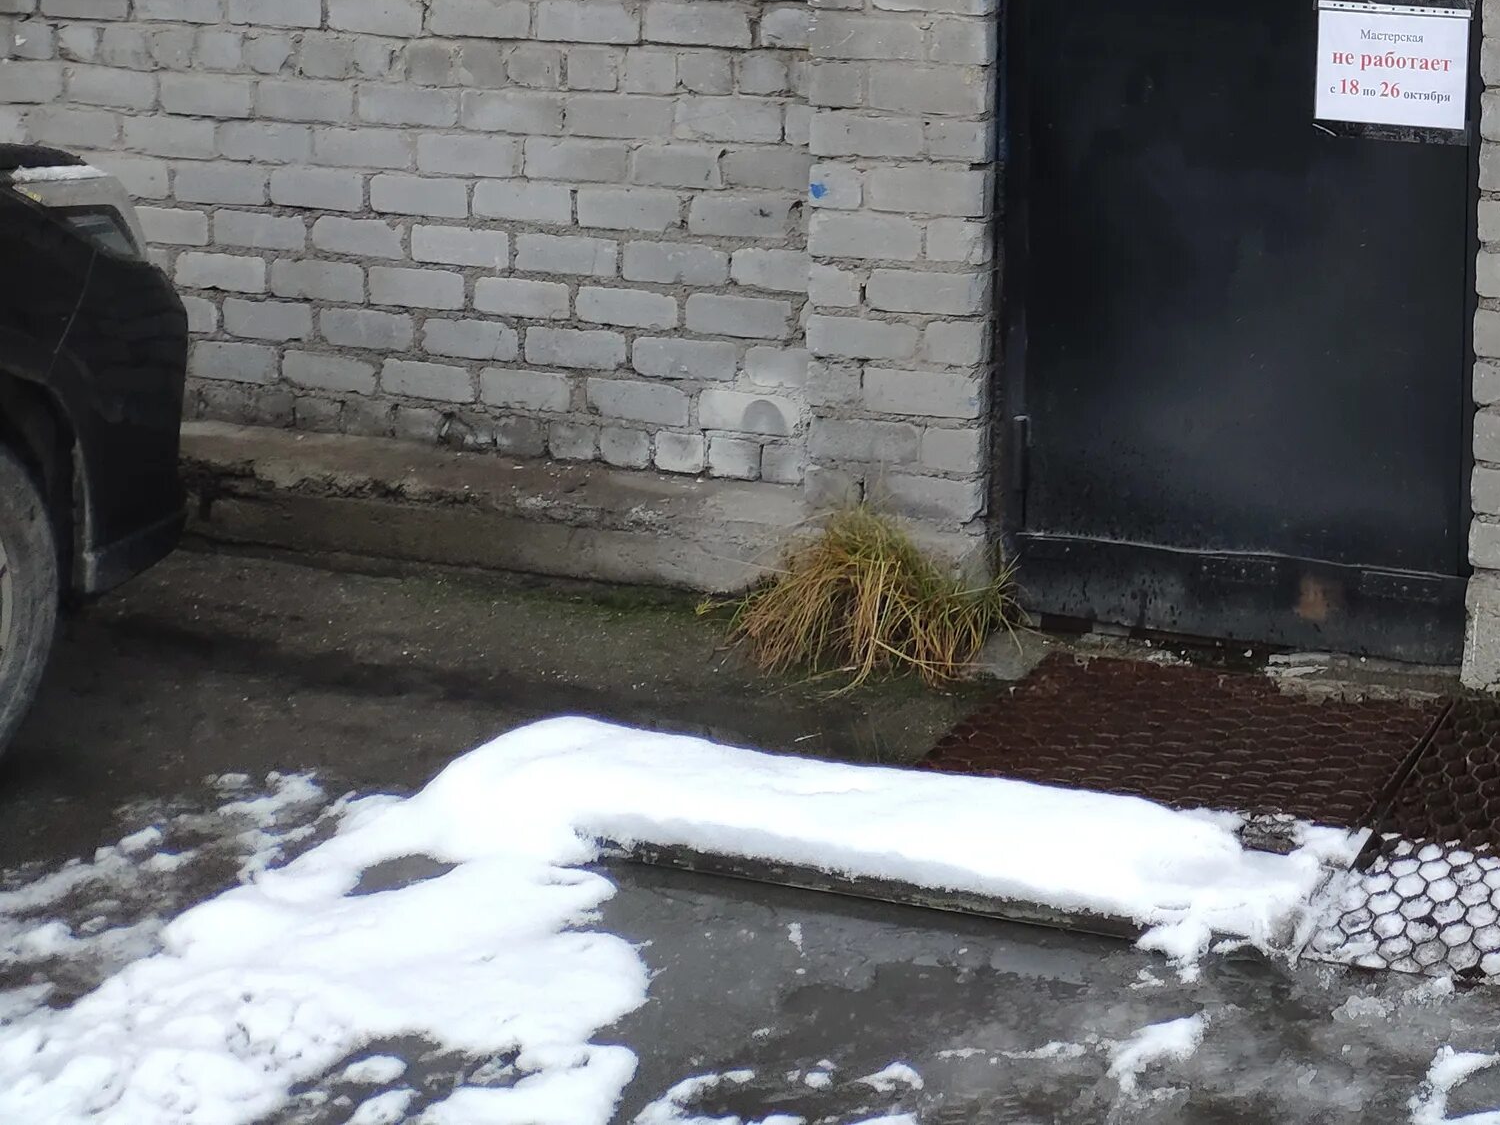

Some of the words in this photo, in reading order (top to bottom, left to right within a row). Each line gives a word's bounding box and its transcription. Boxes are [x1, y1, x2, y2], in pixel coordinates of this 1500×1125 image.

[1360, 28, 1424, 44] Мастерская
[1332, 51, 1354, 65] не
[1359, 51, 1452, 72] работает
[1330, 85, 1336, 94] с
[1339, 78, 1359, 95] 18
[1362, 88, 1376, 97] по
[1379, 81, 1400, 98] 26
[1403, 89, 1451, 104] октября
